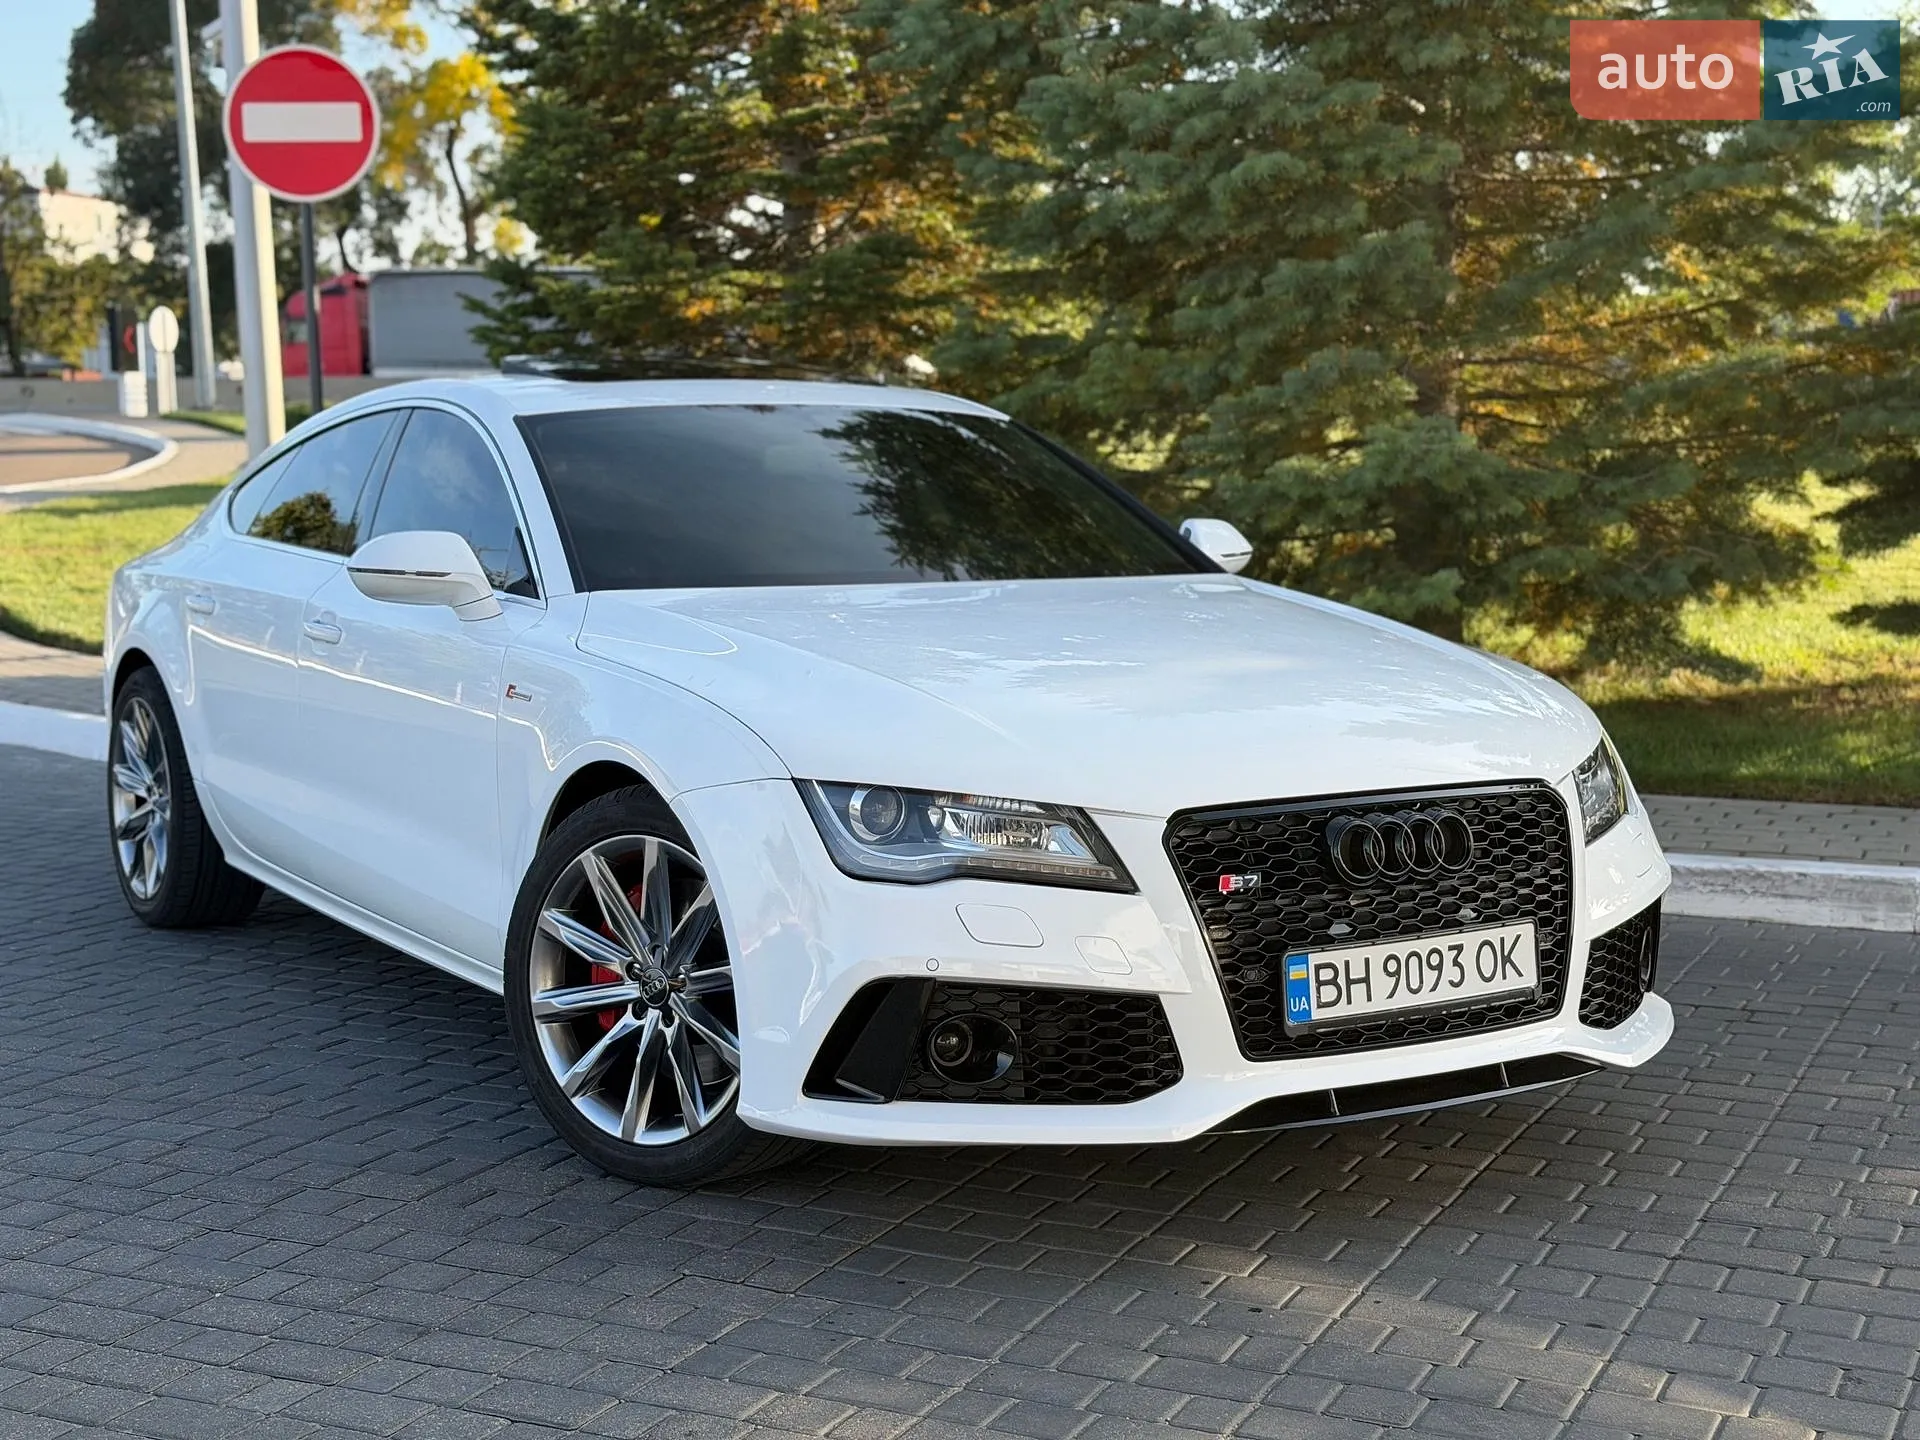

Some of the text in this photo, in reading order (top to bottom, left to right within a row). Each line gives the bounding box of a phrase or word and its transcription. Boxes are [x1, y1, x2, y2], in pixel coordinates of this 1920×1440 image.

[1313, 933, 1525, 1009] BH 9093 OK
[1290, 996, 1309, 1012] UA
